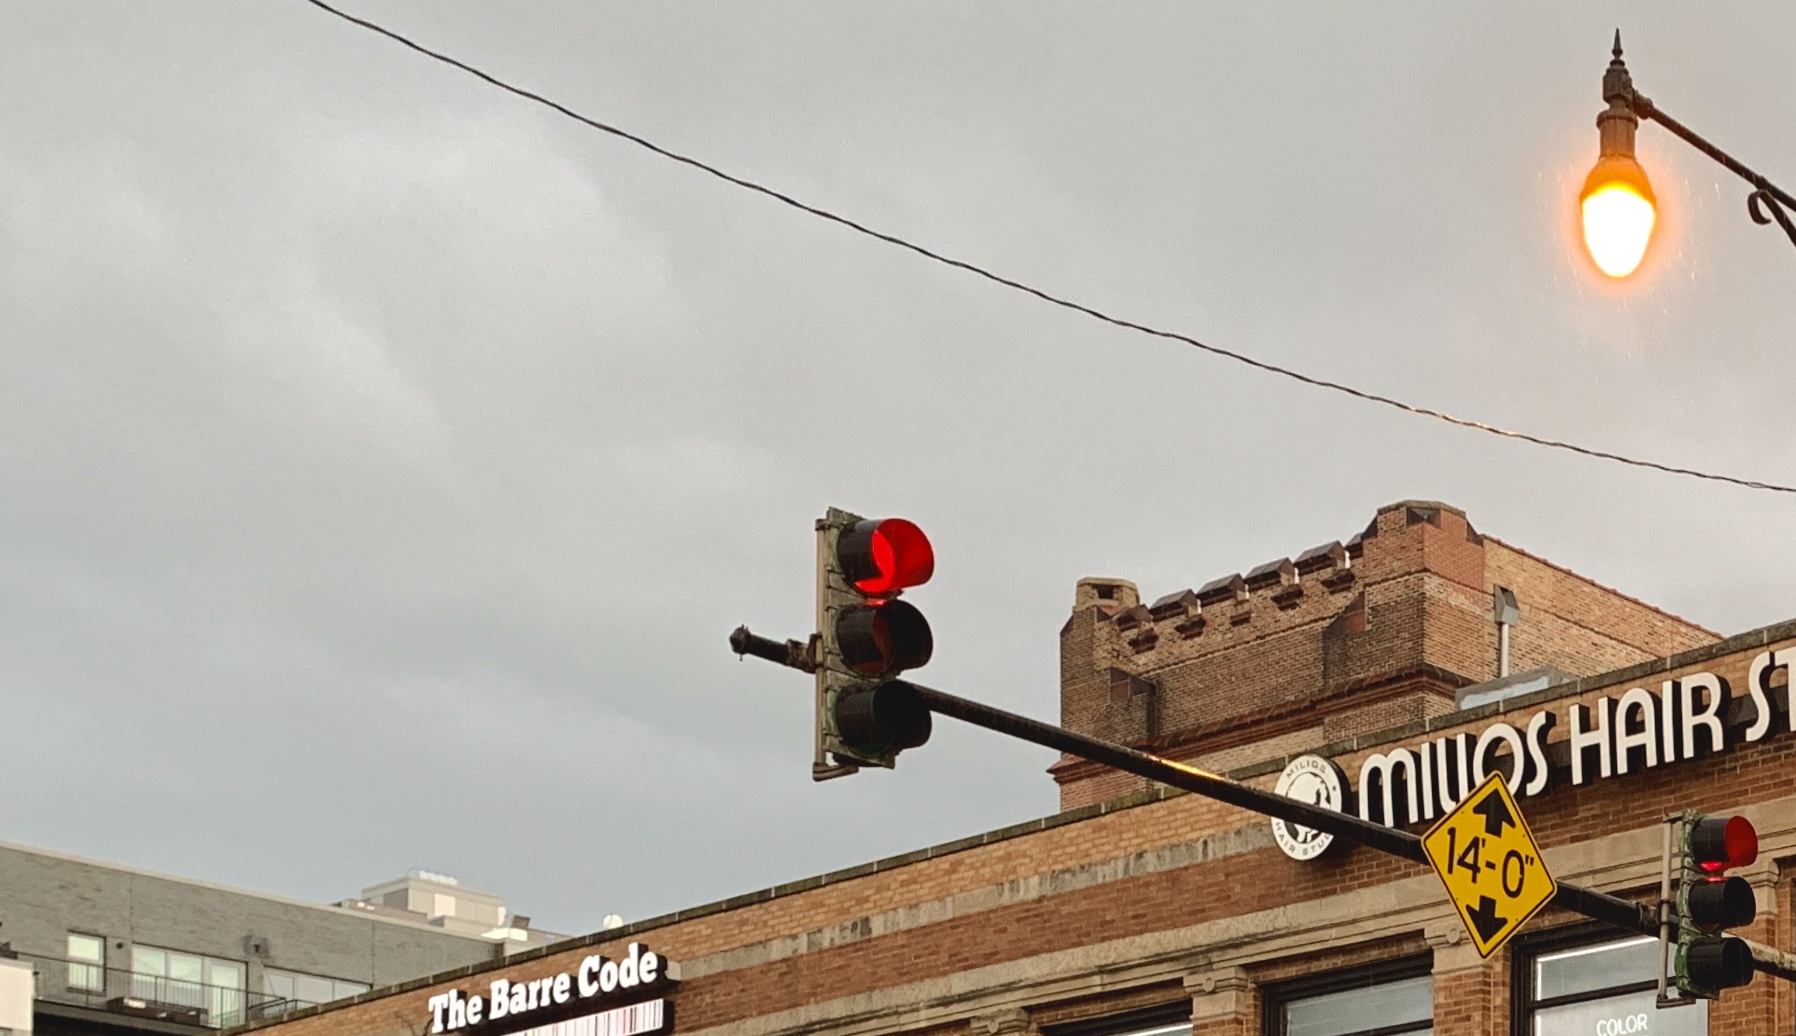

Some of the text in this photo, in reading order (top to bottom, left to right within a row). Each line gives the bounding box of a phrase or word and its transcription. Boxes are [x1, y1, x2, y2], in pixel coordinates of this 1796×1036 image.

[1286, 759, 1327, 779] MILIOS
[1358, 710, 1548, 828] MILIOS
[1569, 672, 1724, 786] HAIR
[1275, 821, 1331, 856] HAIR STUD
[428, 942, 658, 1034] The Barre Code
